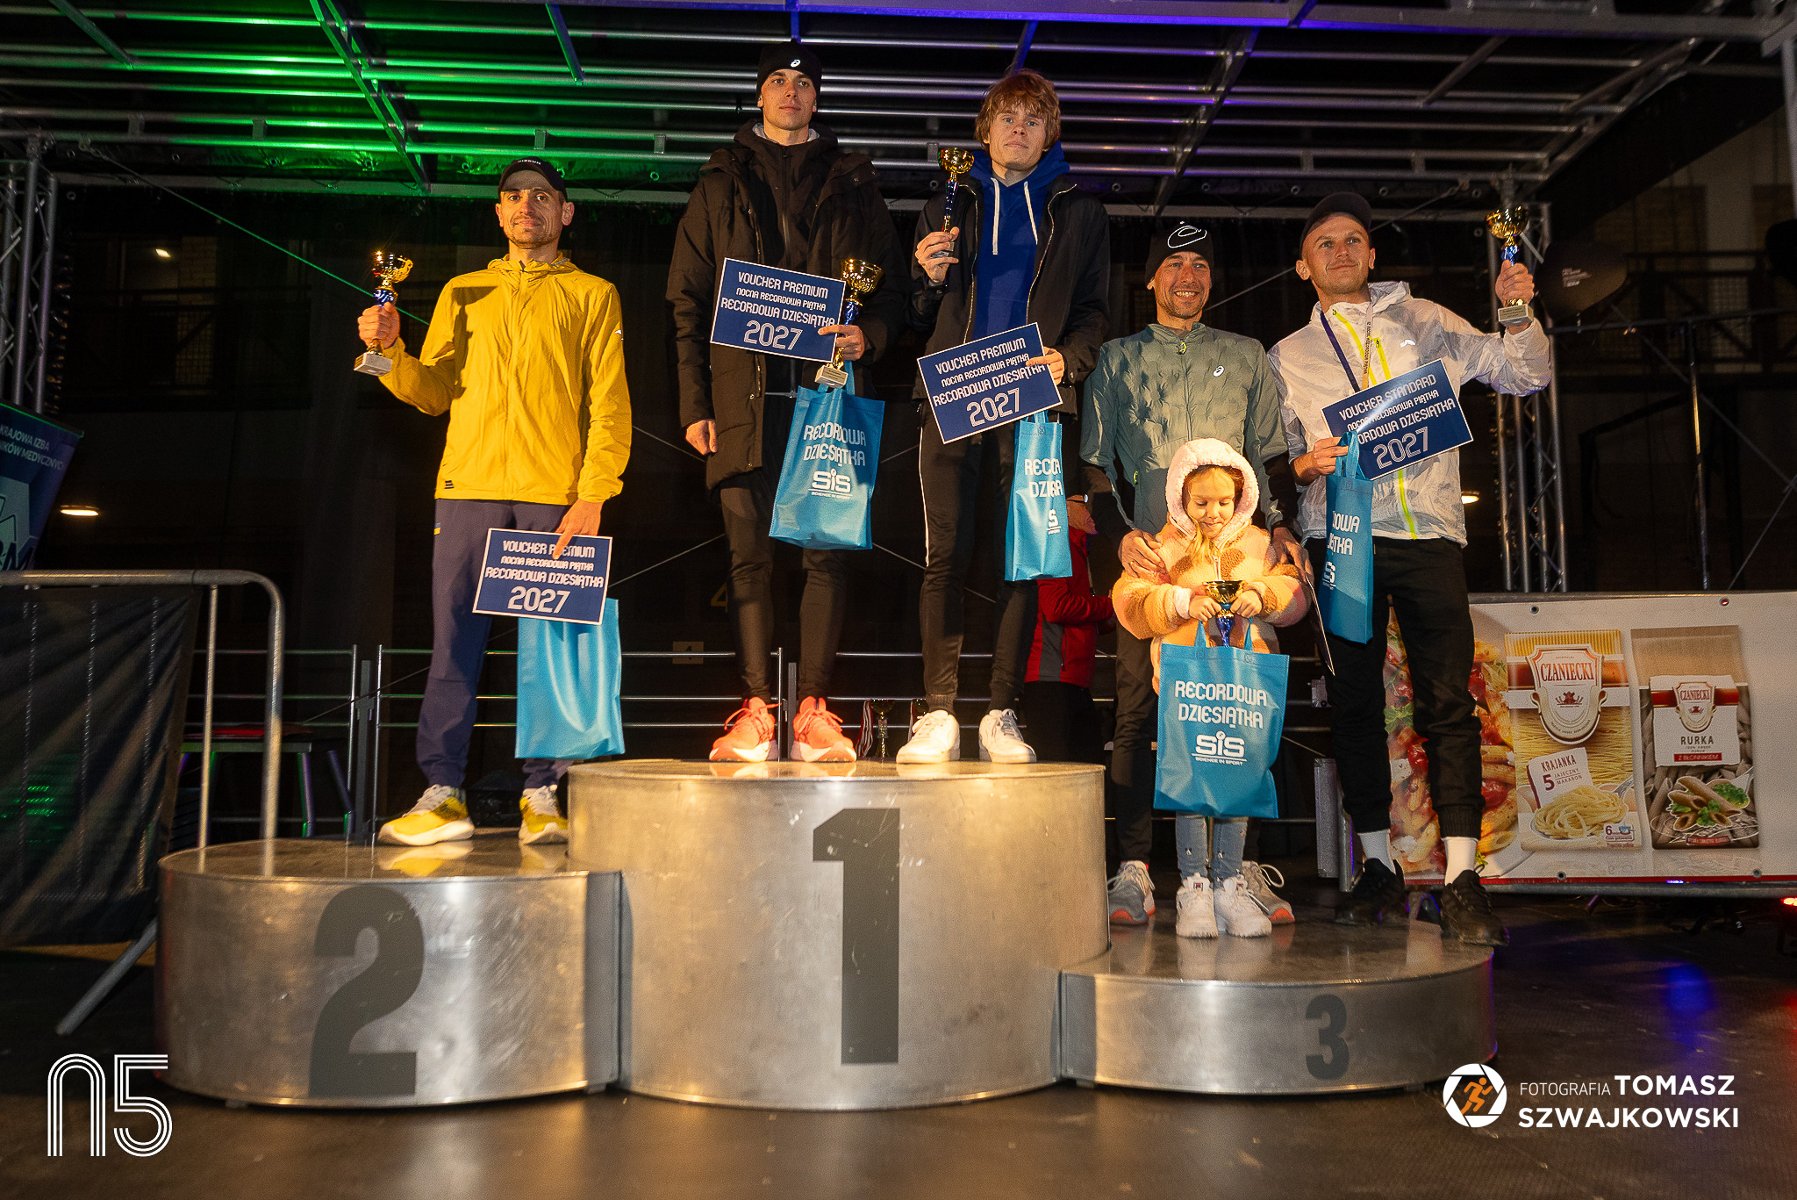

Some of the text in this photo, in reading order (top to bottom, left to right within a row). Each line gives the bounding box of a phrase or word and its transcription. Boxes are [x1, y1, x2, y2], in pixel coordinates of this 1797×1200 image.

[738, 271, 829, 300] VOUCHER PREMIUM
[720, 297, 836, 328] RECORDOWA DZIESIĄTKA
[736, 287, 826, 312] NOCNA RECORDOWA PIĄTKA
[744, 319, 804, 351] 2027
[934, 337, 1026, 375] VOUCHER PREMIUM
[940, 353, 1030, 388] NOCNA RECORDOWA PIĄTKA
[932, 364, 1046, 406] RECORDOWA DZIESIĄTKA
[1339, 374, 1437, 422] VOUCHER STANDARD
[1414, 390, 1440, 406] PIĄTKA
[966, 387, 1020, 428] 2027
[1358, 398, 1457, 444] ORDOWA DZIESIĄTKA
[33, 437, 50, 452] IZBA
[804, 422, 866, 446] RECORDOWA
[803, 443, 866, 466] DZIESIĄTKA
[1372, 426, 1430, 470] 2027
[502, 540, 596, 558] VOUCHER PEMIUM
[484, 566, 604, 589] RECORDOWA DZIESIĄTKA
[500, 556, 594, 573] NOCNA RECORDOWA PIĄTKA
[507, 586, 571, 614] 2027
[1540, 662, 1594, 682] CZANIECKI
[1175, 680, 1268, 707] RECORDOWA
[1178, 704, 1264, 729] DZIESIĄTKA
[1680, 736, 1714, 745] RURKA
[1541, 754, 1577, 772] KRAJANKA
[1542, 774, 1554, 791] 5
[1606, 826, 1612, 835] 6
[813, 808, 900, 1064] 1
[308, 886, 424, 1097] 2
[1305, 994, 1350, 1080] 3
